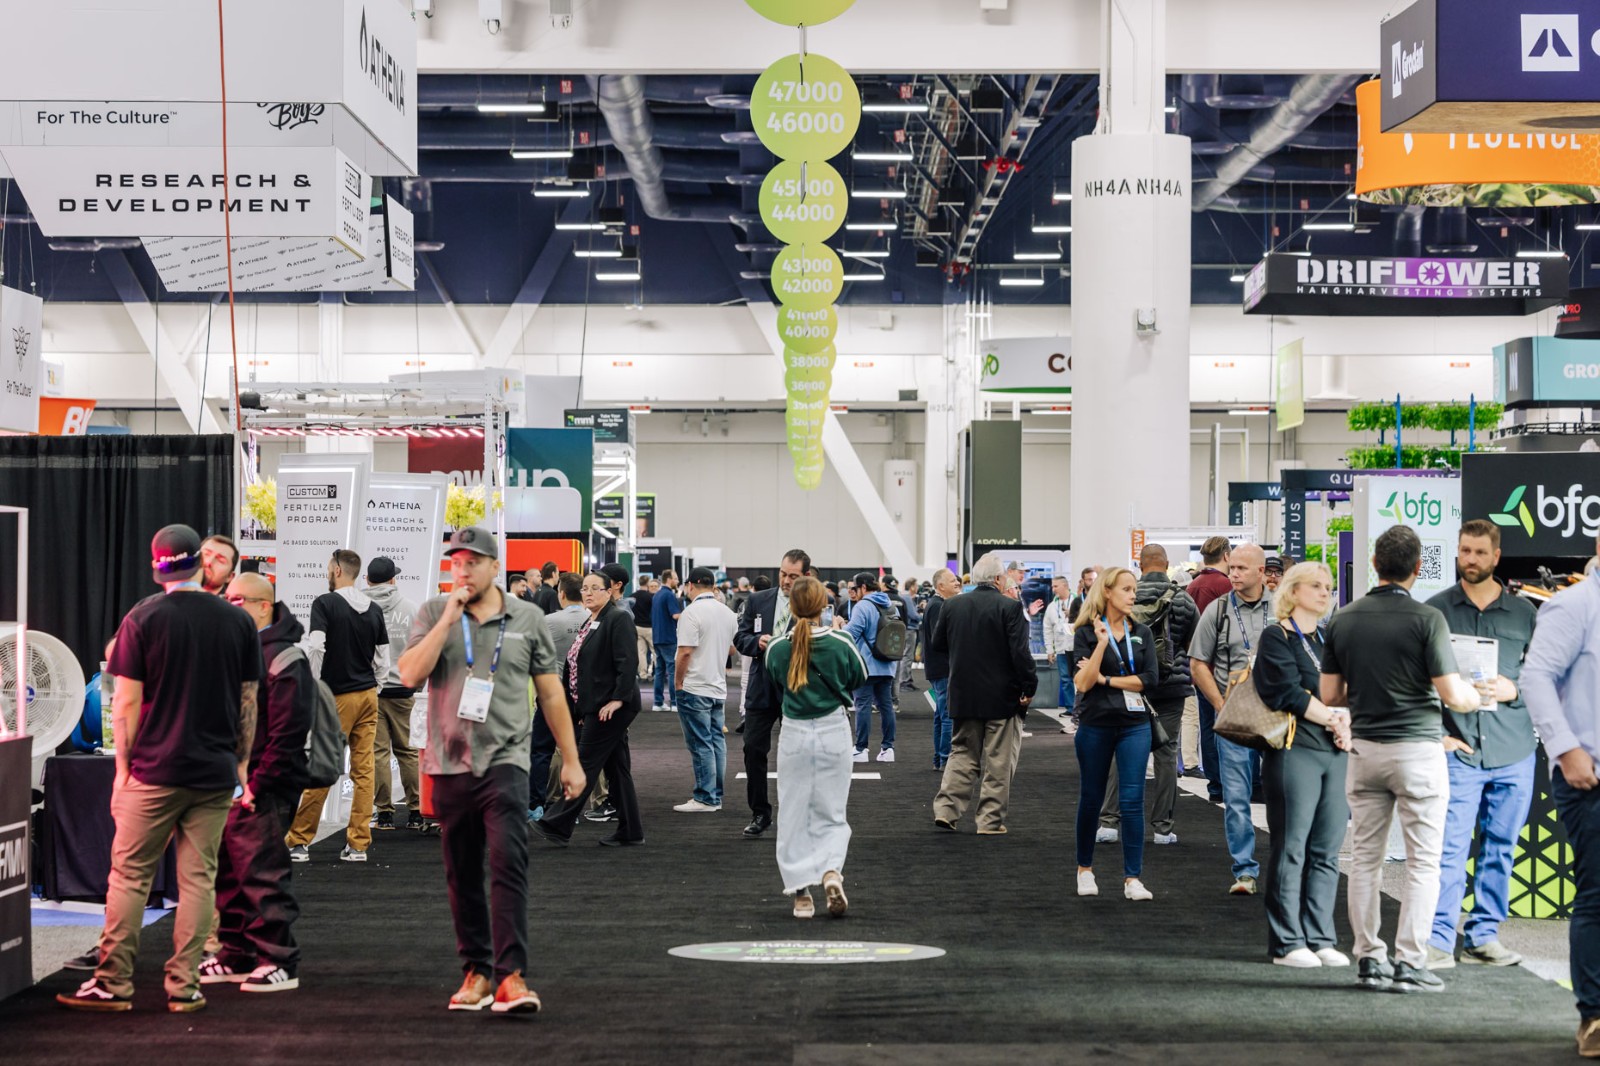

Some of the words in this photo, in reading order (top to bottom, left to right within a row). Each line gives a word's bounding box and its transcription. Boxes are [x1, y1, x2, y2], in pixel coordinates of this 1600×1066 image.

[370, 34, 404, 116] ATHENA
[769, 81, 842, 102] 47000
[38, 111, 64, 124] For
[70, 110, 102, 124] The
[767, 112, 844, 133] 46000
[96, 174, 276, 188] RESEARCH
[294, 174, 312, 188] &
[772, 180, 834, 196] 45000
[59, 199, 311, 212] DEVELOPMENT
[772, 204, 834, 221] 44000
[782, 259, 832, 273] 43000
[1297, 258, 1541, 286] DRIFLOWER
[782, 280, 833, 293] 42000
[1297, 286, 1454, 296] HANGHARVESTING
[1467, 288, 1542, 296] SYSTEMS
[786, 326, 830, 338] 40000
[790, 356, 829, 368] 38000
[1048, 353, 1072, 374] C
[1564, 364, 1600, 378] GRO
[290, 488, 326, 496] CUSTOM
[284, 504, 342, 512] FERTILIZER
[379, 502, 420, 510] ATHENA
[1290, 502, 1300, 522] US
[1404, 492, 1442, 526] bfg
[1536, 484, 1600, 538] bfg
[1134, 532, 1144, 558] NEW
[1290, 530, 1301, 558] ITH
